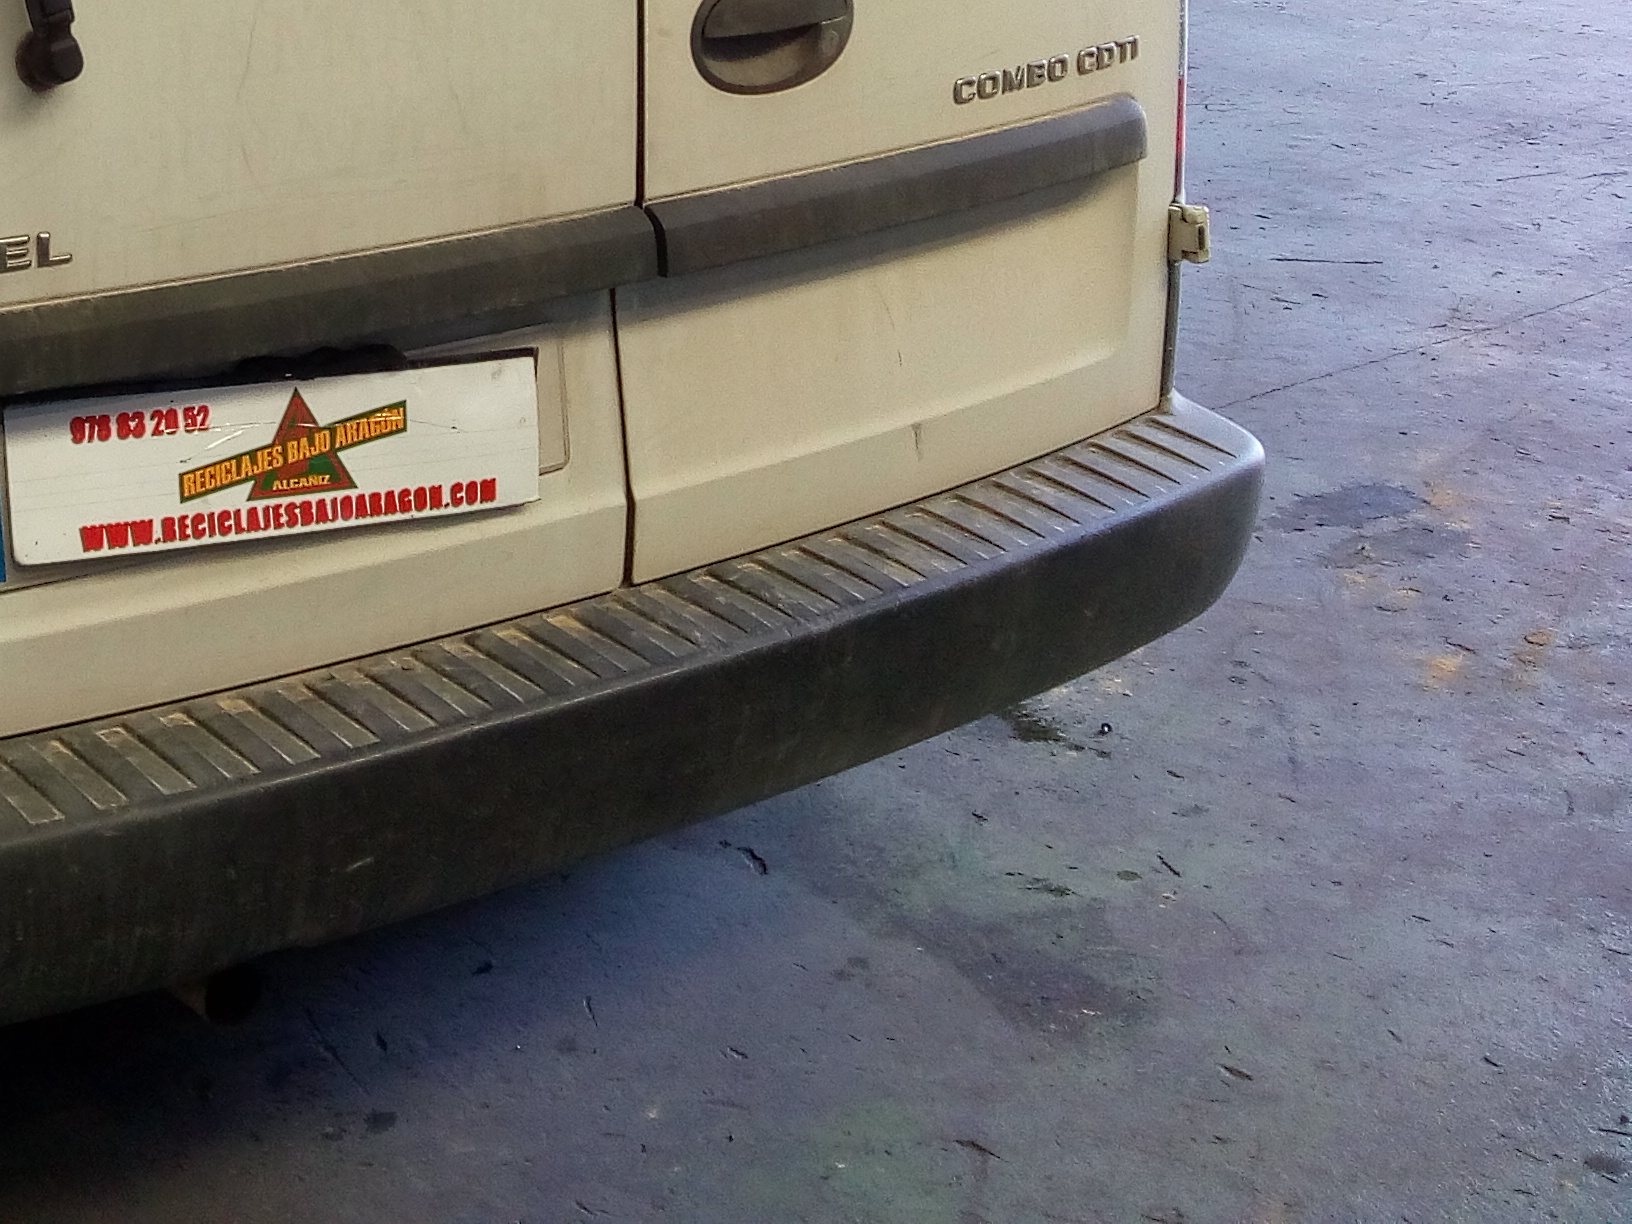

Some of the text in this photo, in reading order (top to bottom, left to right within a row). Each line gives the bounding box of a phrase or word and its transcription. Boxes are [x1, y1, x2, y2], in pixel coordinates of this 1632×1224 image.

[953, 34, 1140, 105] COMBO CDTI
[70, 414, 111, 444] 978
[183, 404, 210, 433] 52
[183, 445, 284, 498] RECICLAJES
[287, 430, 331, 464] BAJO
[79, 477, 497, 553] WWW.RECICLAJESBAJOARAGON.COM
